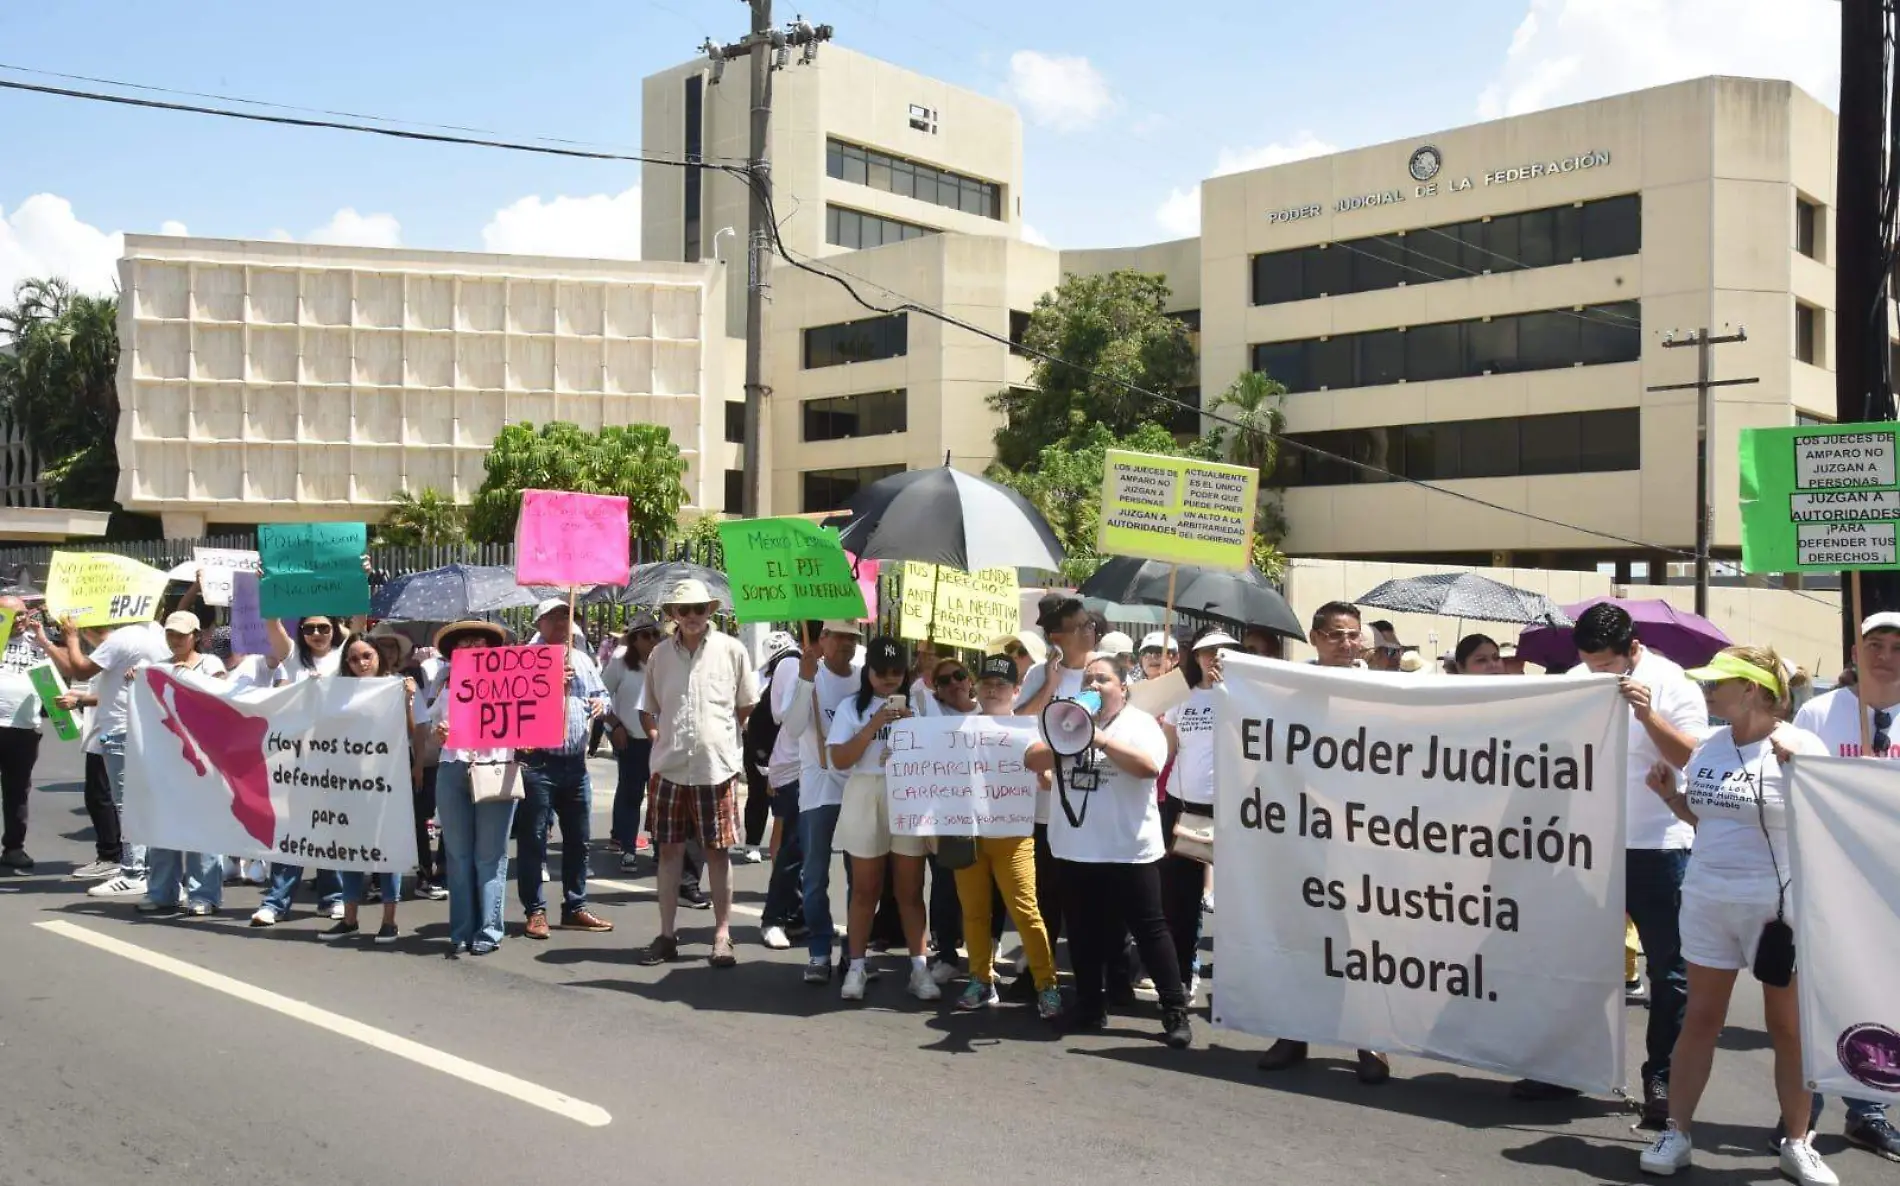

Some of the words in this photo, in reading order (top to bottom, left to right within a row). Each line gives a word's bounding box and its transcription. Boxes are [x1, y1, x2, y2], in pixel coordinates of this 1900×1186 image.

[1269, 204, 1322, 224] PODER
[1333, 190, 1405, 213] JUDICIAL
[1415, 183, 1438, 198] DE
[1449, 177, 1472, 192] LA
[1484, 150, 1610, 186] FEDERACIÓN
[1796, 435, 1821, 446] LOS
[1823, 434, 1873, 445] JUECES
[1877, 433, 1896, 443] DE
[1805, 448, 1862, 459] AMPARO
[1865, 448, 1884, 457] NO
[1114, 463, 1131, 471] LOS
[1133, 466, 1165, 476] JUECES
[1184, 468, 1248, 482] ACTUALMENTE
[1813, 463, 1864, 474] JUZGAN
[1868, 463, 1877, 471] A
[1120, 474, 1156, 485] AMPARO
[1157, 479, 1170, 487] NO
[1190, 479, 1201, 487] ES
[1202, 481, 1213, 489] EL
[1123, 486, 1157, 496] JUZGAN
[1190, 490, 1219, 499] PODER
[1221, 493, 1240, 502] QUE
[1807, 492, 1868, 504] JUZGAN
[1873, 492, 1884, 502] A
[1183, 500, 1211, 509] PUEDE
[1214, 503, 1243, 513] PONER
[1118, 509, 1158, 520] JUZGAN
[1160, 513, 1167, 521] A
[1184, 511, 1198, 519] UN
[1199, 513, 1221, 522] ALTO
[1793, 508, 1900, 522] AUTORIDADES
[1107, 519, 1177, 535] AUTORIDADES
[1177, 521, 1245, 535] ARBITRARIEDAD
[1827, 523, 1866, 536] ¡PARA
[1197, 534, 1242, 546] GOBIERNO
[1799, 537, 1867, 548] DEFENDER
[1871, 537, 1896, 546] TUS
[1808, 552, 1879, 562] DERECHOS
[766, 561, 788, 577] EL
[796, 557, 824, 579] PJF
[908, 562, 928, 578] TUS
[937, 569, 1008, 598] DERECHOS
[742, 584, 787, 601] SOMOS
[793, 583, 807, 598] TU
[809, 583, 856, 598] DEFENSA
[109, 595, 153, 618] #PJF
[948, 595, 963, 610] LA
[970, 599, 1018, 621] NEGATIVA
[904, 602, 922, 618] DE
[997, 619, 1014, 635] TU
[472, 647, 553, 672] TODOS
[456, 674, 551, 703] SOMOS
[480, 700, 537, 739] PJF
[268, 731, 301, 758] Hoy
[309, 738, 338, 754] nos
[343, 737, 389, 755] toca
[892, 730, 924, 751] EL
[944, 730, 1012, 749] JUEZ
[1240, 718, 1273, 762] El
[1286, 723, 1413, 777] Poder
[1422, 735, 1593, 792] Judicial
[892, 759, 993, 777] IMPARCIAL
[1697, 767, 1714, 780] EL
[1721, 771, 1755, 783] PJF
[272, 763, 393, 793] defendernos,
[892, 784, 972, 800] CARRERA
[312, 809, 349, 829] para
[1240, 787, 1286, 834] de
[1299, 793, 1332, 839] la
[1346, 801, 1592, 869] Federación
[280, 833, 387, 862] defenderte.
[1302, 875, 1346, 911] es
[1357, 874, 1520, 932] Justicia
[1324, 936, 1498, 1001] Laboral.
